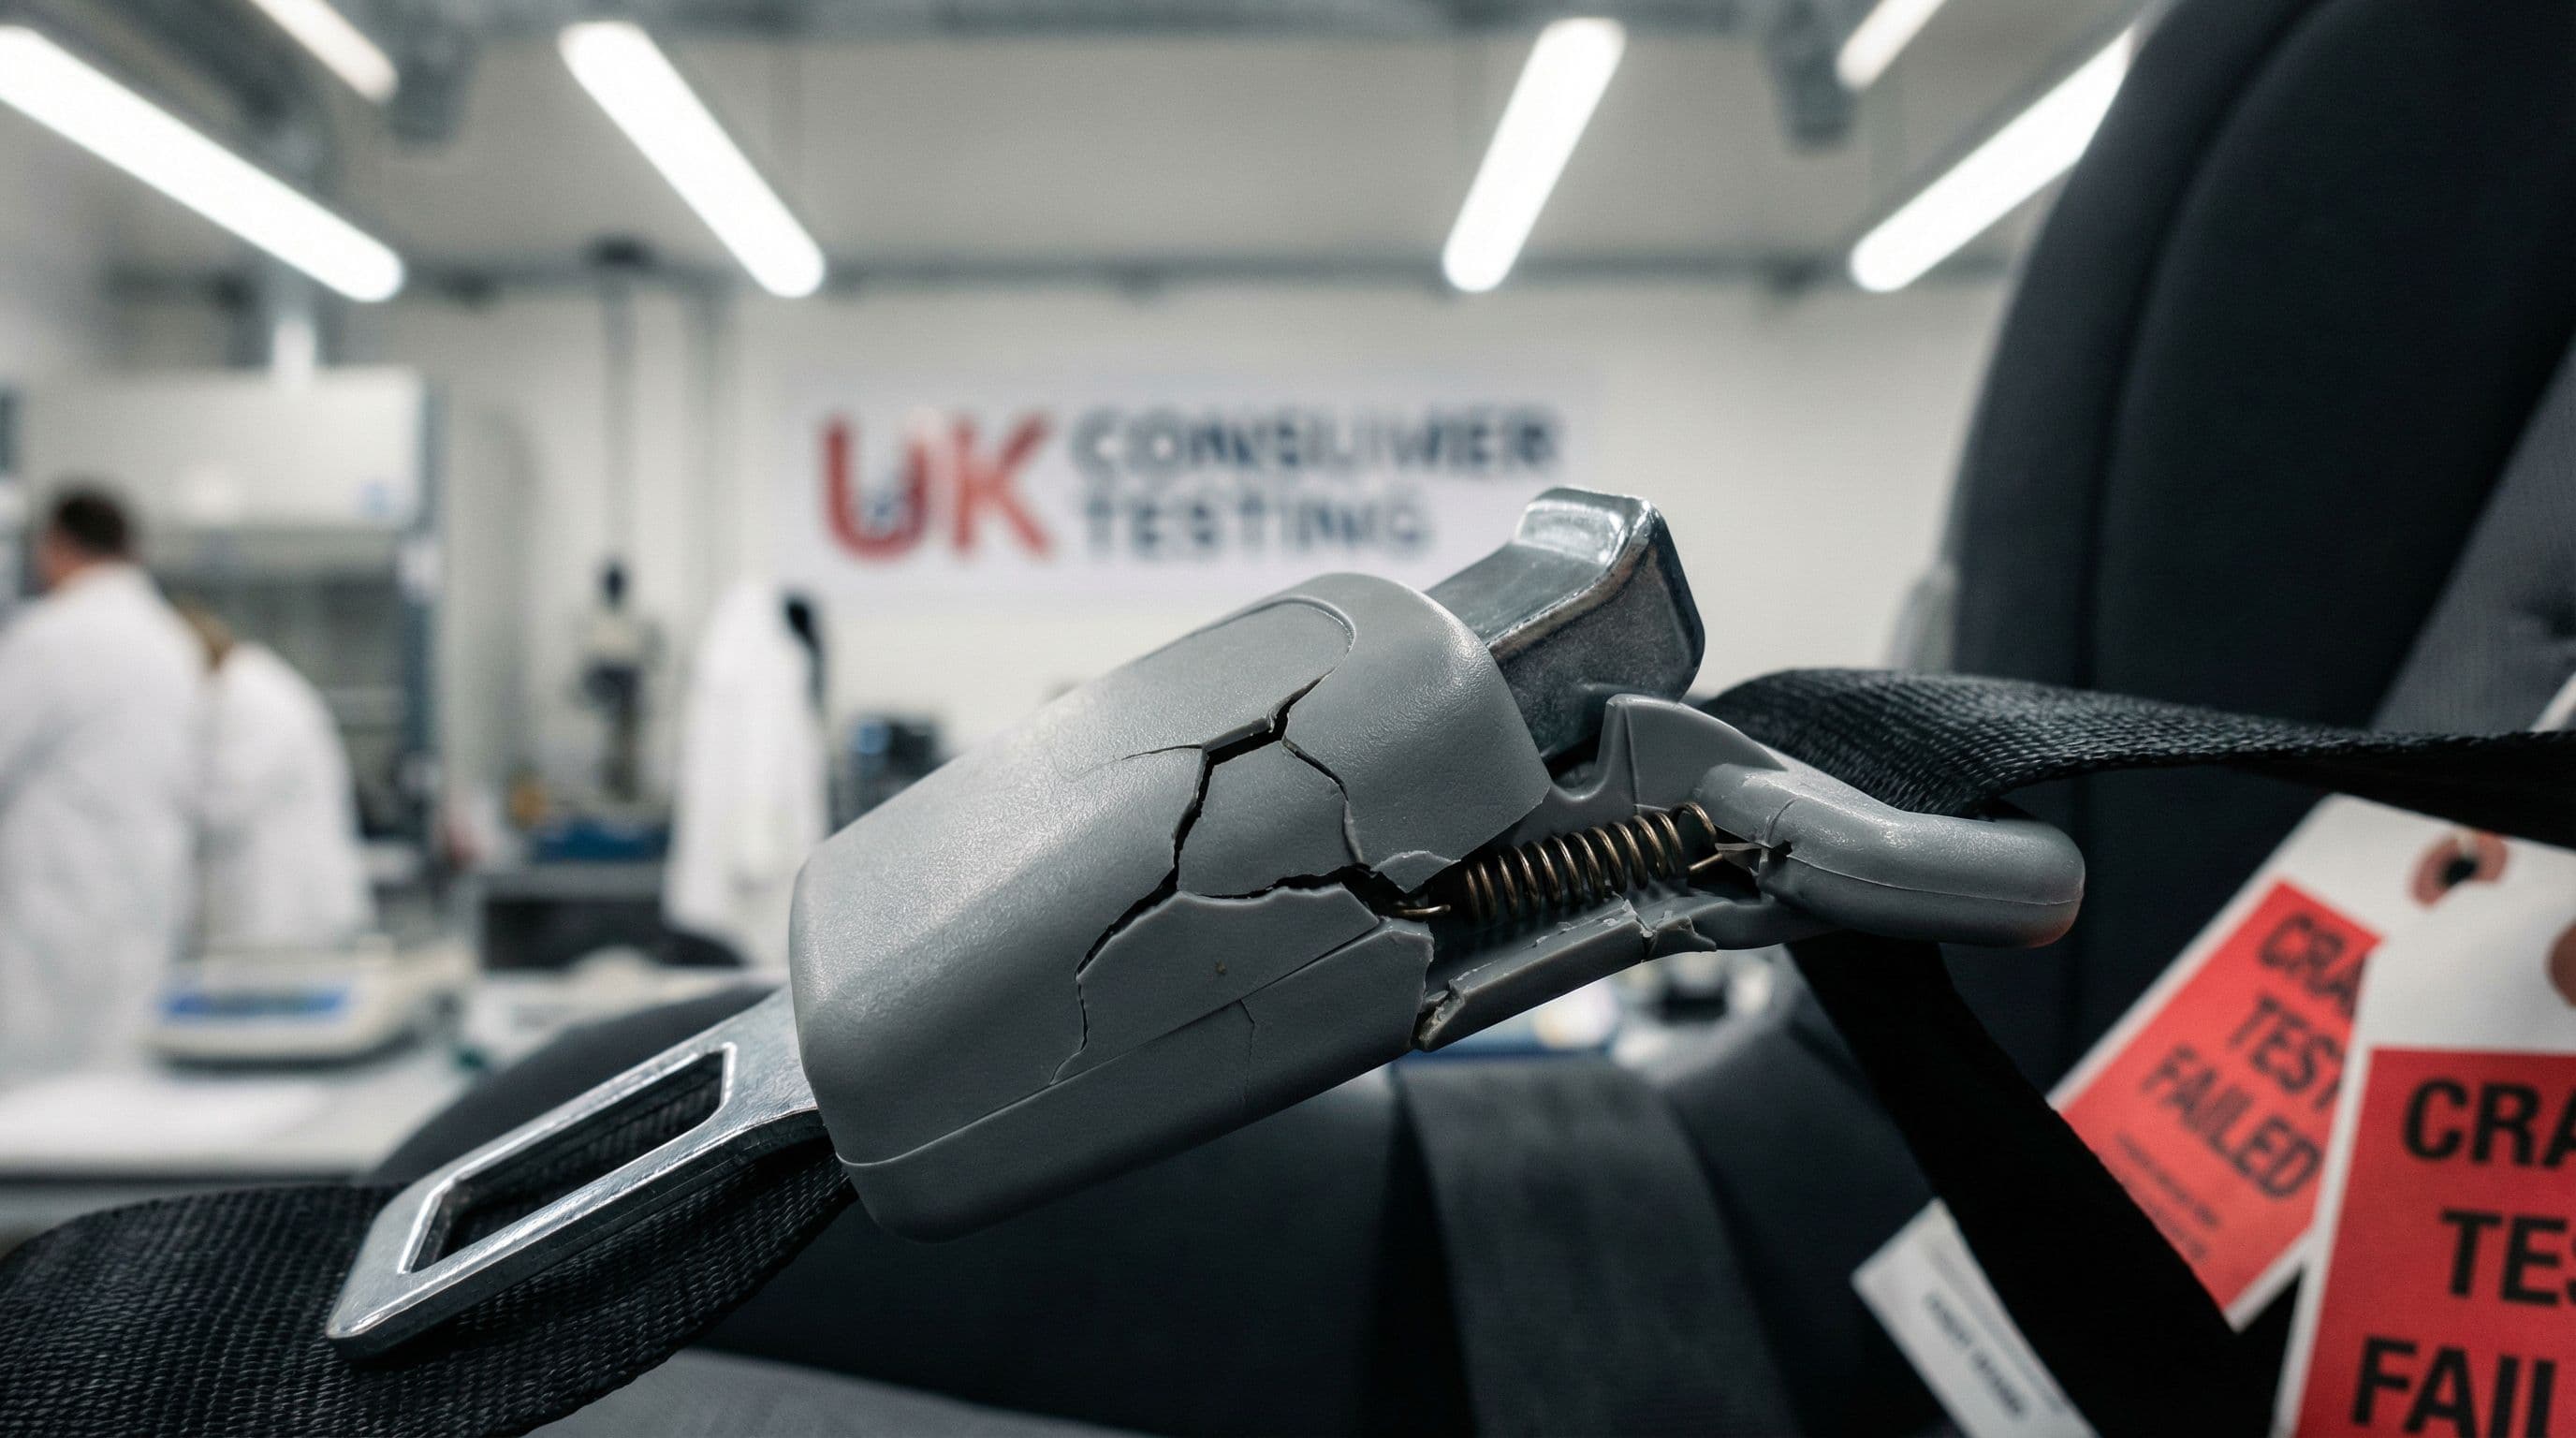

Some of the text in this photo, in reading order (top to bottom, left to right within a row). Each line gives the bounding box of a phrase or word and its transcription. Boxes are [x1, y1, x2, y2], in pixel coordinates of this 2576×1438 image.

[822, 412, 1056, 560] UK
[1083, 492, 1432, 558] TESTING
[2142, 1045, 2323, 1199] FAILED
[2440, 1208, 2576, 1307] TE
